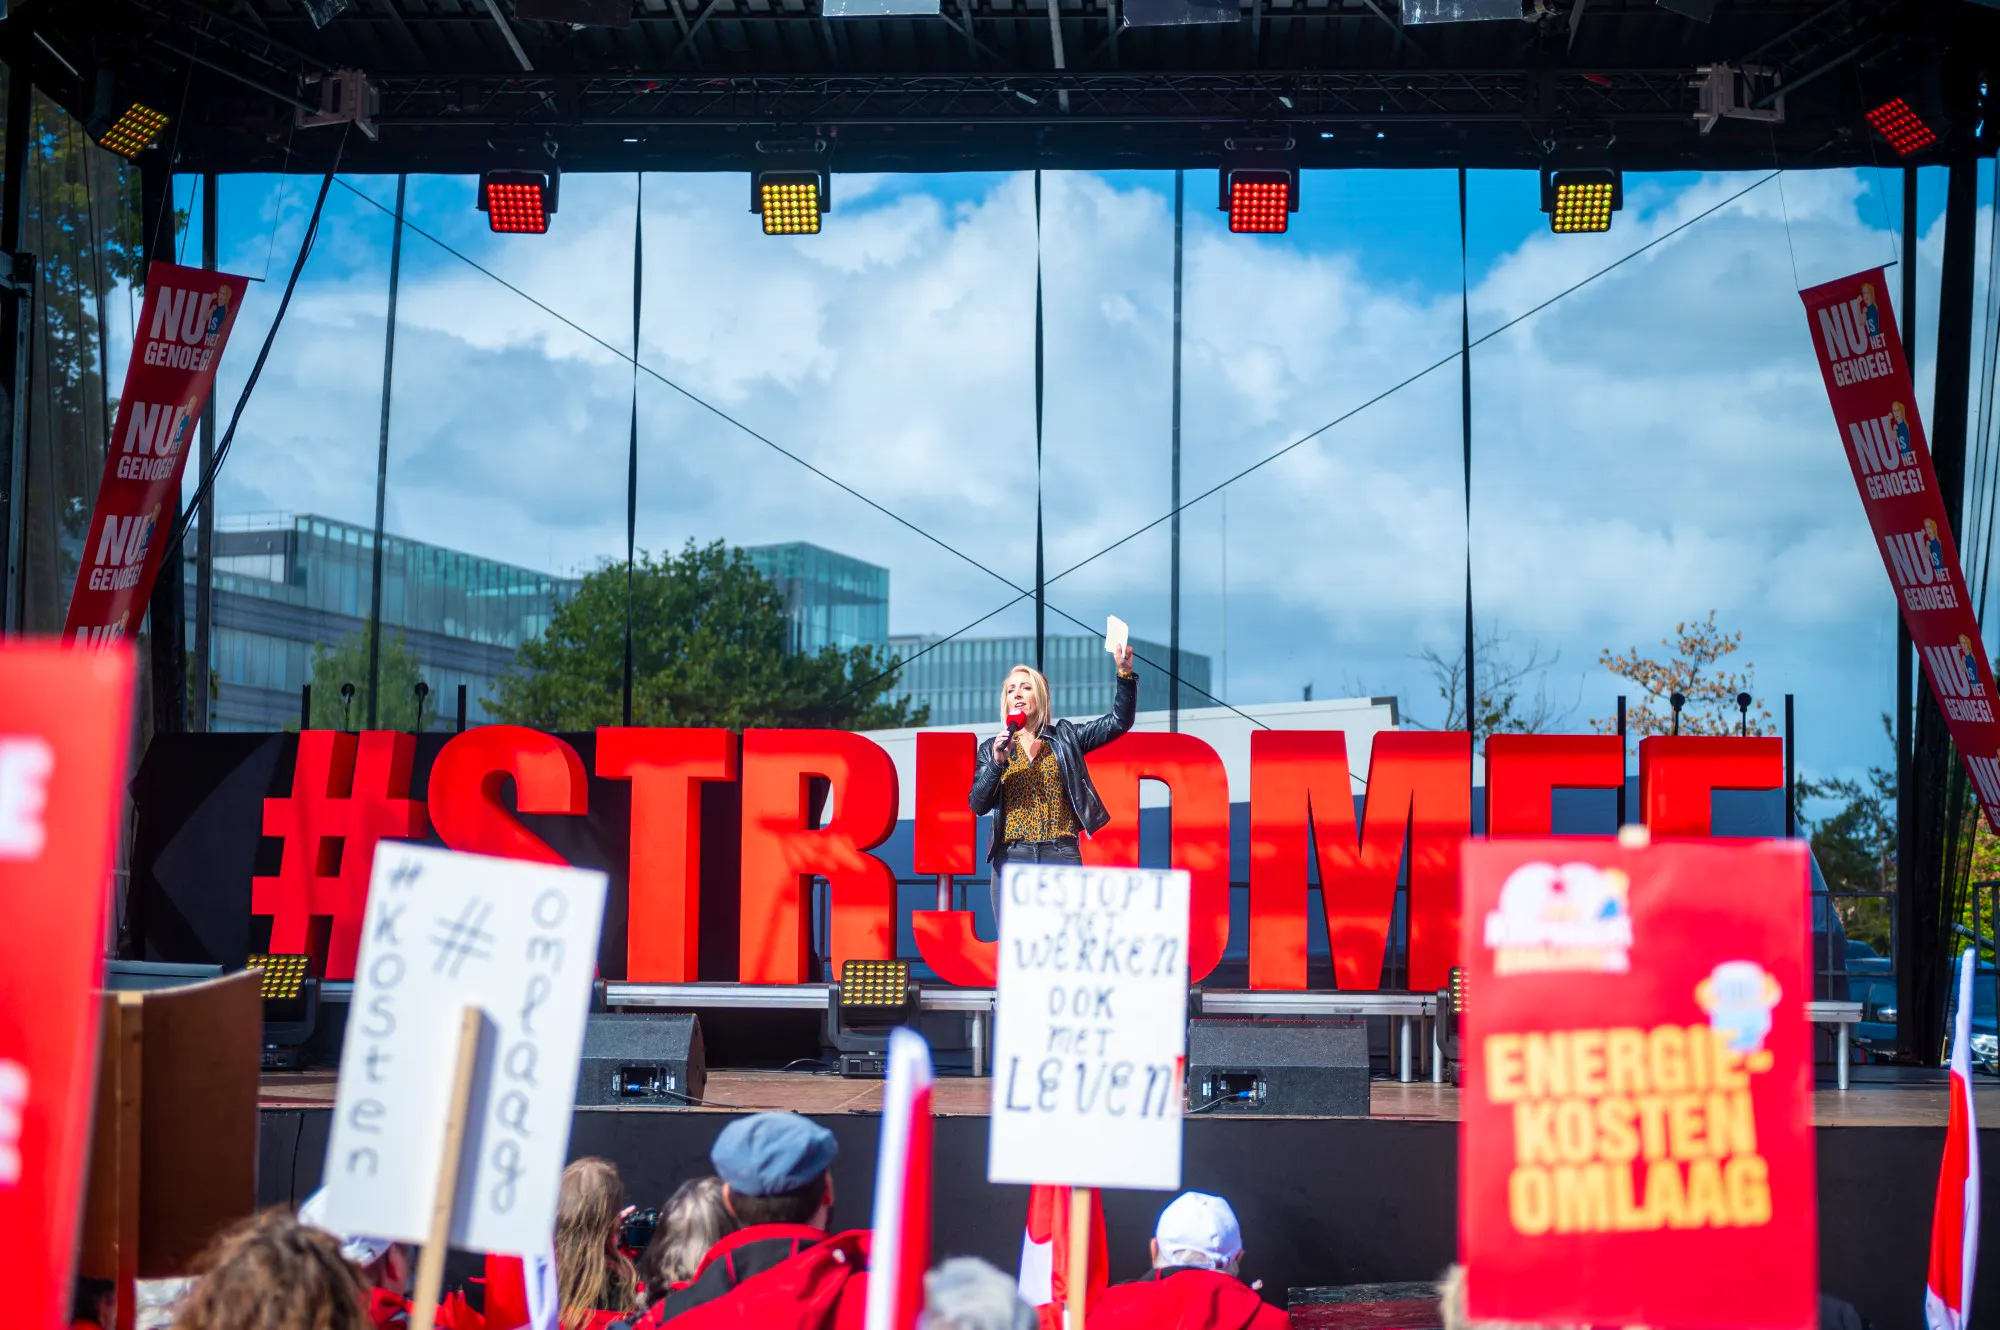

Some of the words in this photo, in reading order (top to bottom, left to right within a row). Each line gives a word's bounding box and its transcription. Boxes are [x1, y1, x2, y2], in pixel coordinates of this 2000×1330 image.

[149, 286, 212, 345] NU
[1818, 299, 1868, 361] NU
[1865, 318, 1876, 334] IS
[204, 334, 220, 347] HET
[1869, 333, 1887, 350] HET
[144, 341, 215, 372] GENOEG!
[1832, 350, 1894, 387] GENOEG!
[122, 401, 185, 455] NU
[1896, 435, 1907, 450] IS
[1849, 416, 1899, 475] NU
[1901, 451, 1918, 467] HET
[117, 456, 176, 481] GENOEG!
[1865, 468, 1925, 500] GENOEG!
[95, 514, 152, 566] NU
[1885, 532, 1934, 585] NU
[1929, 552, 1940, 566] IS
[89, 564, 144, 591] GENOEG!
[1935, 568, 1951, 582] HET
[1903, 585, 1959, 611] GENOEG!
[1924, 646, 1970, 697] NU
[1966, 667, 1976, 681] IS
[1972, 683, 1987, 697] HET
[1945, 699, 1995, 723] GENOEG!
[1484, 1021, 1774, 1104] ENERGIE-
[1512, 1093, 1758, 1165] KOSTEN
[1508, 1154, 1773, 1236] OMLAAG
